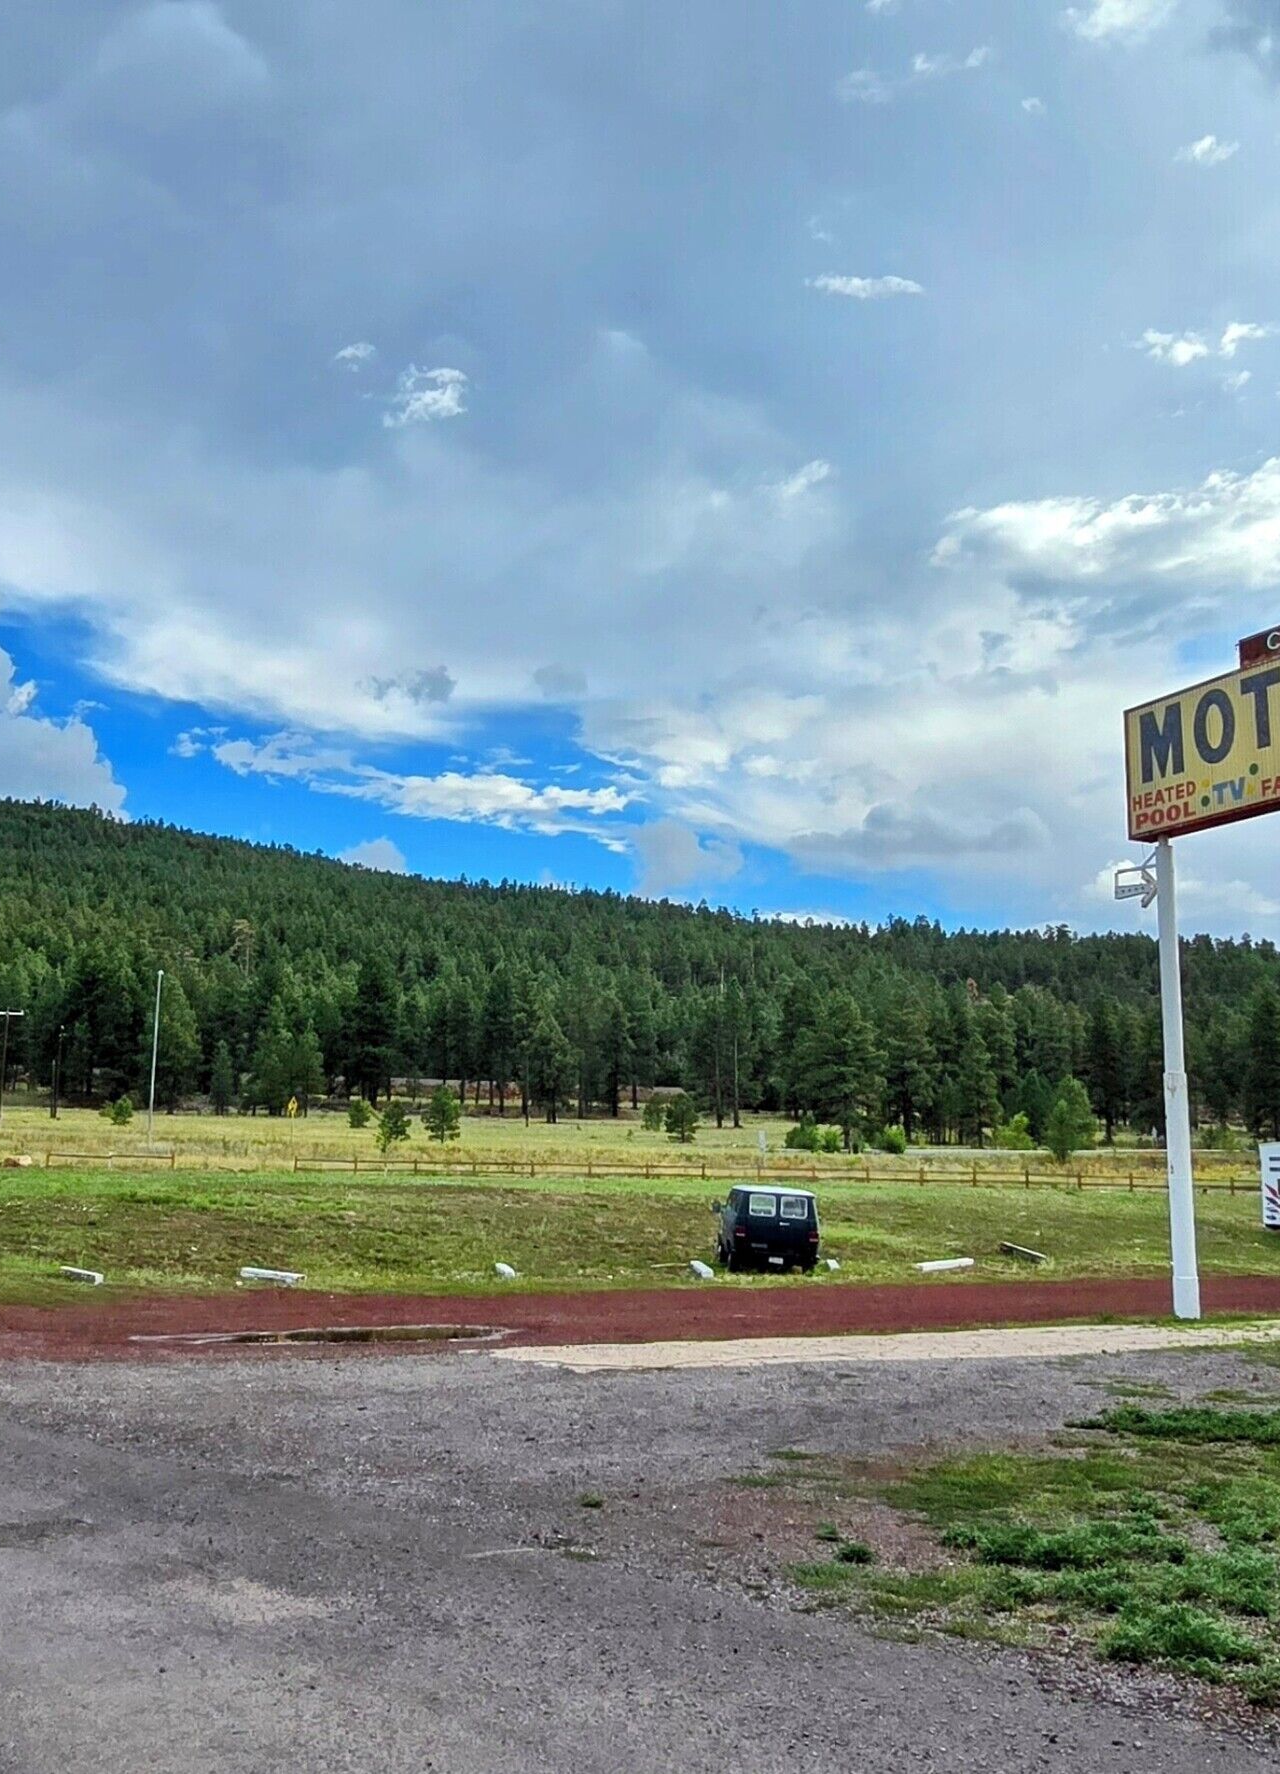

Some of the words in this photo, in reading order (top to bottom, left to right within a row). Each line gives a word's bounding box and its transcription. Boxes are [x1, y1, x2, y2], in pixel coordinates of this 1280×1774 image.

[1132, 781, 1197, 812] HEATED
[1212, 776, 1245, 805] TV
[1135, 801, 1197, 831] POOL
